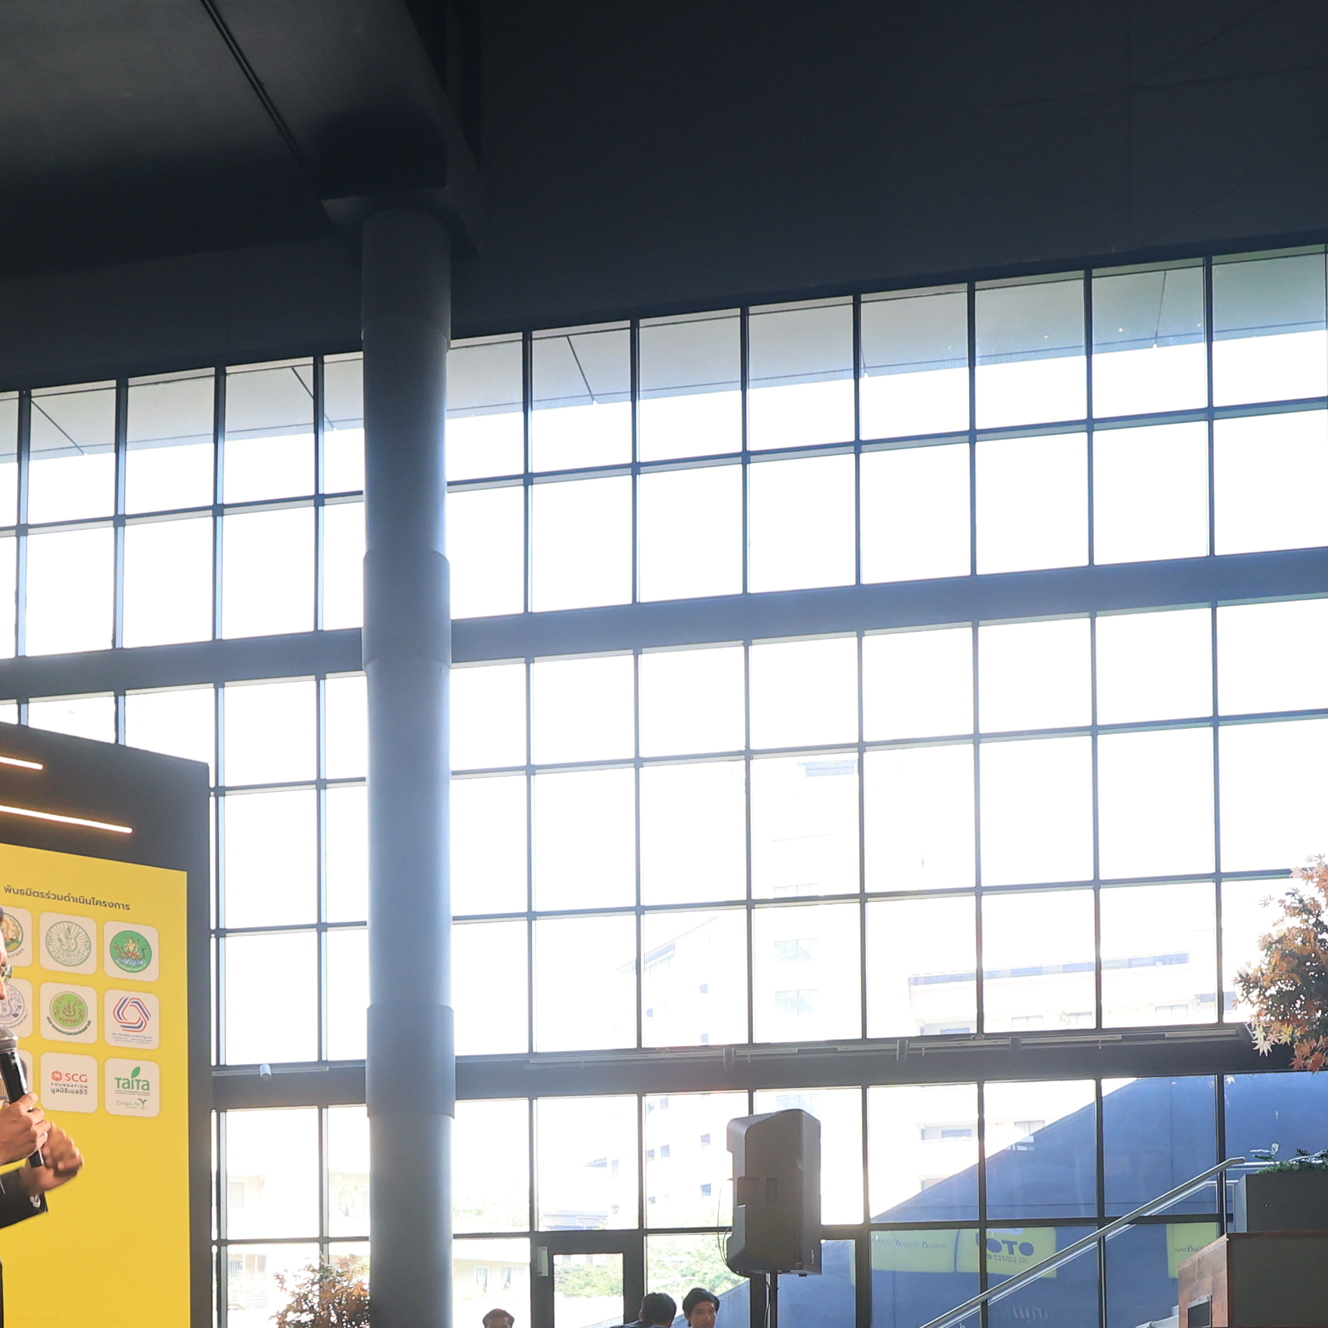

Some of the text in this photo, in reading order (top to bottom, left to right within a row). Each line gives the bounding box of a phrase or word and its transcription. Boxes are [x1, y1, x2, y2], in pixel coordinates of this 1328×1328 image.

[3, 884, 131, 911] พันธมิตรร่วมดำเนินโครงการ
[64, 1072, 88, 1083] SCG
